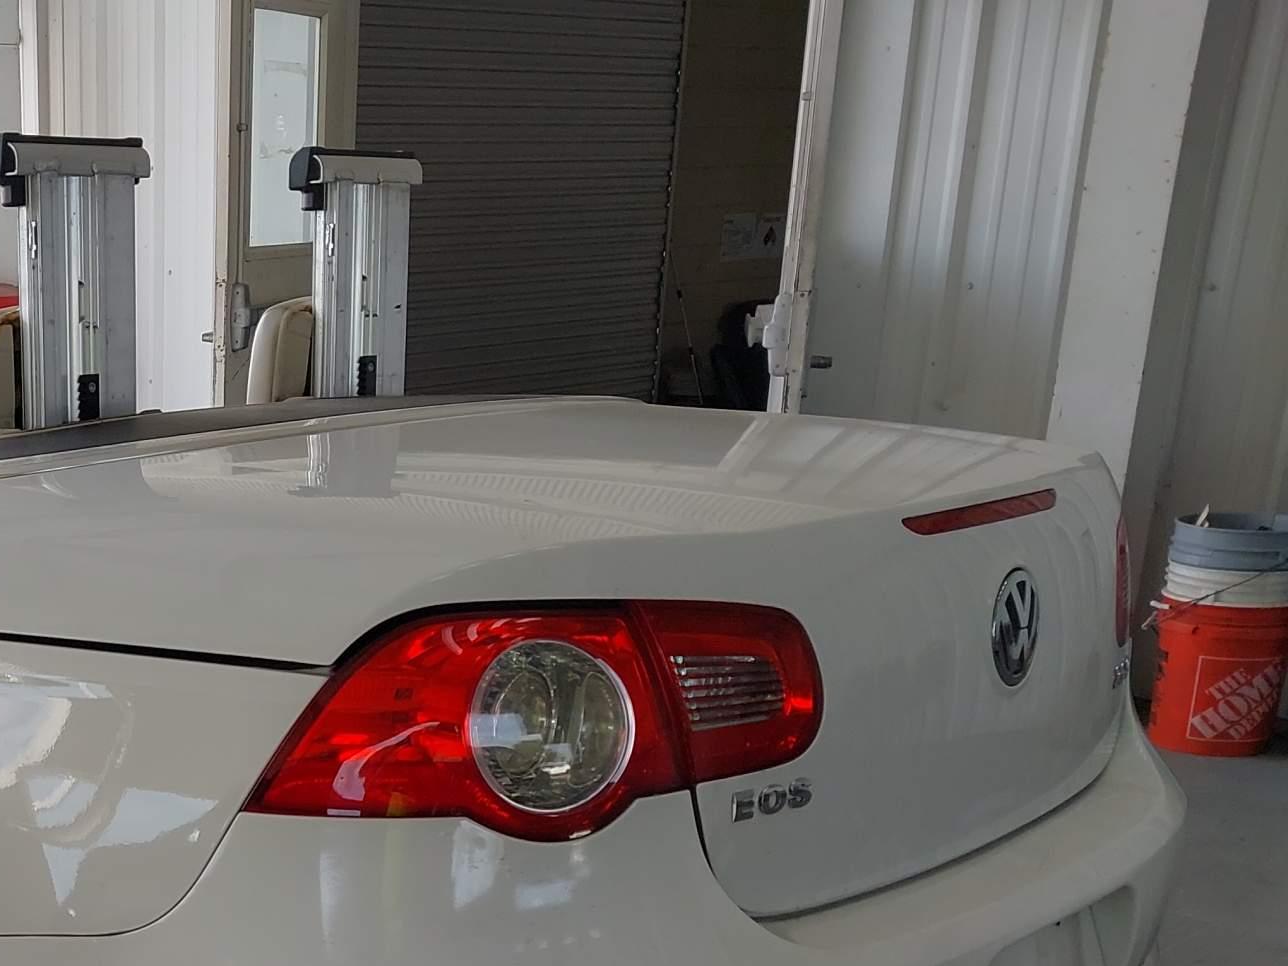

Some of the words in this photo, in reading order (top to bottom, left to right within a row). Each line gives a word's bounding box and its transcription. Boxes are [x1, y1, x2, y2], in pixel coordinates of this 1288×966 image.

[1190, 657, 1287, 739] HOME
[1204, 667, 1253, 701] THE
[731, 777, 812, 823] EOS
